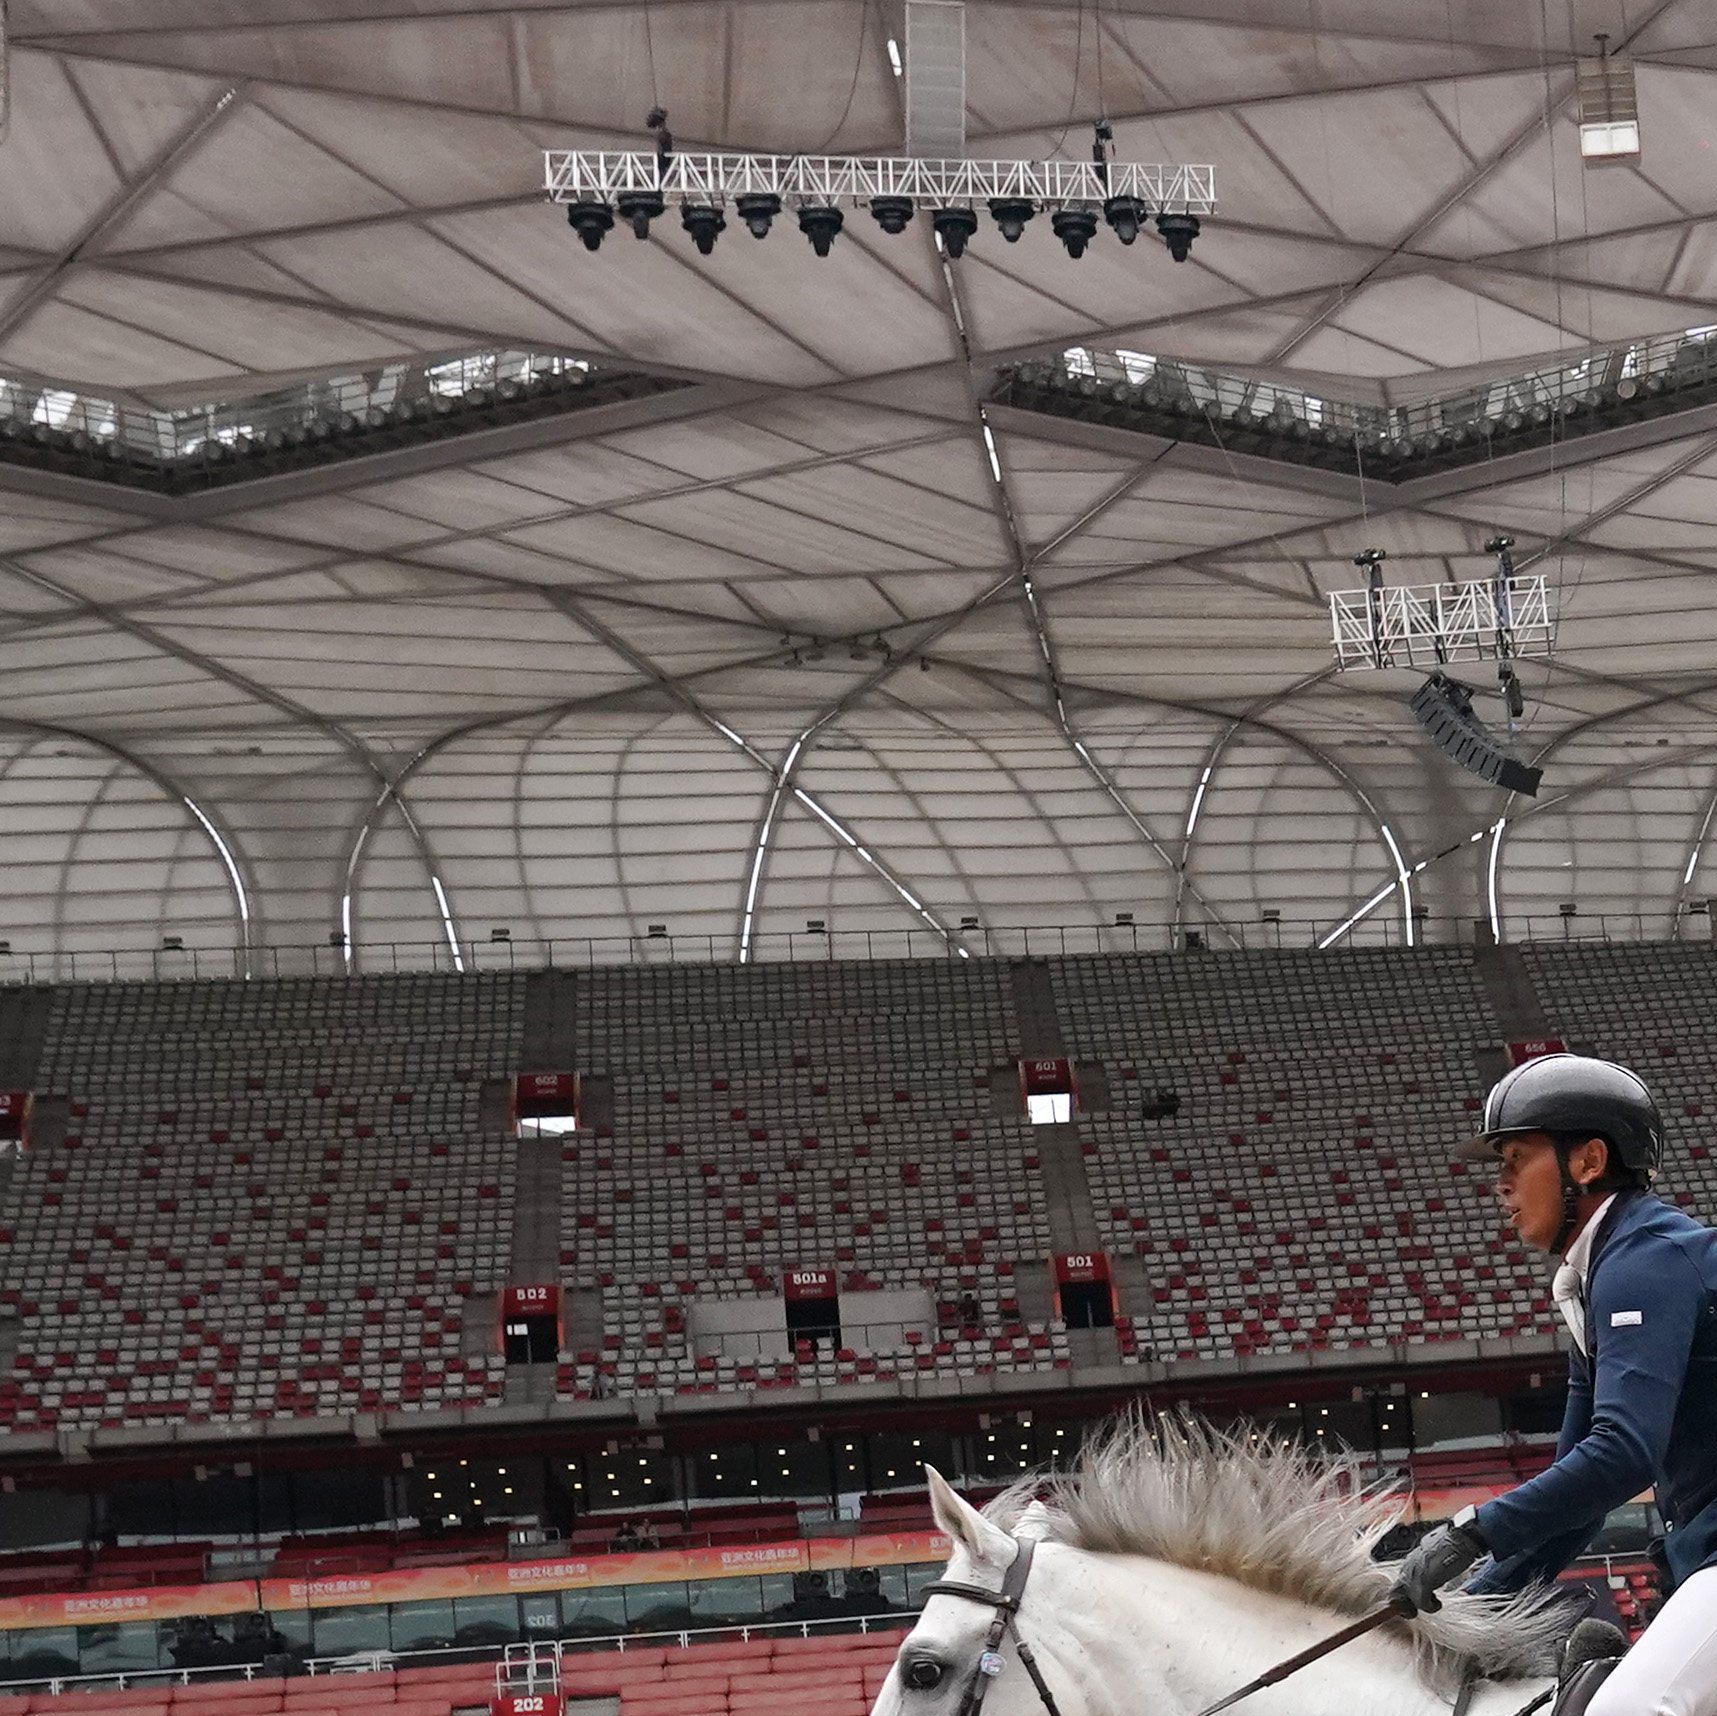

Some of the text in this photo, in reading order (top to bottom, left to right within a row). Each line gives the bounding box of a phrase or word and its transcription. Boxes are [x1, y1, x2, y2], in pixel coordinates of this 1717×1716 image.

[1067, 1255, 1093, 1269] 501
[793, 1272, 827, 1286] 501a
[516, 1287, 548, 1301] 502
[514, 1697, 543, 1713] 202
